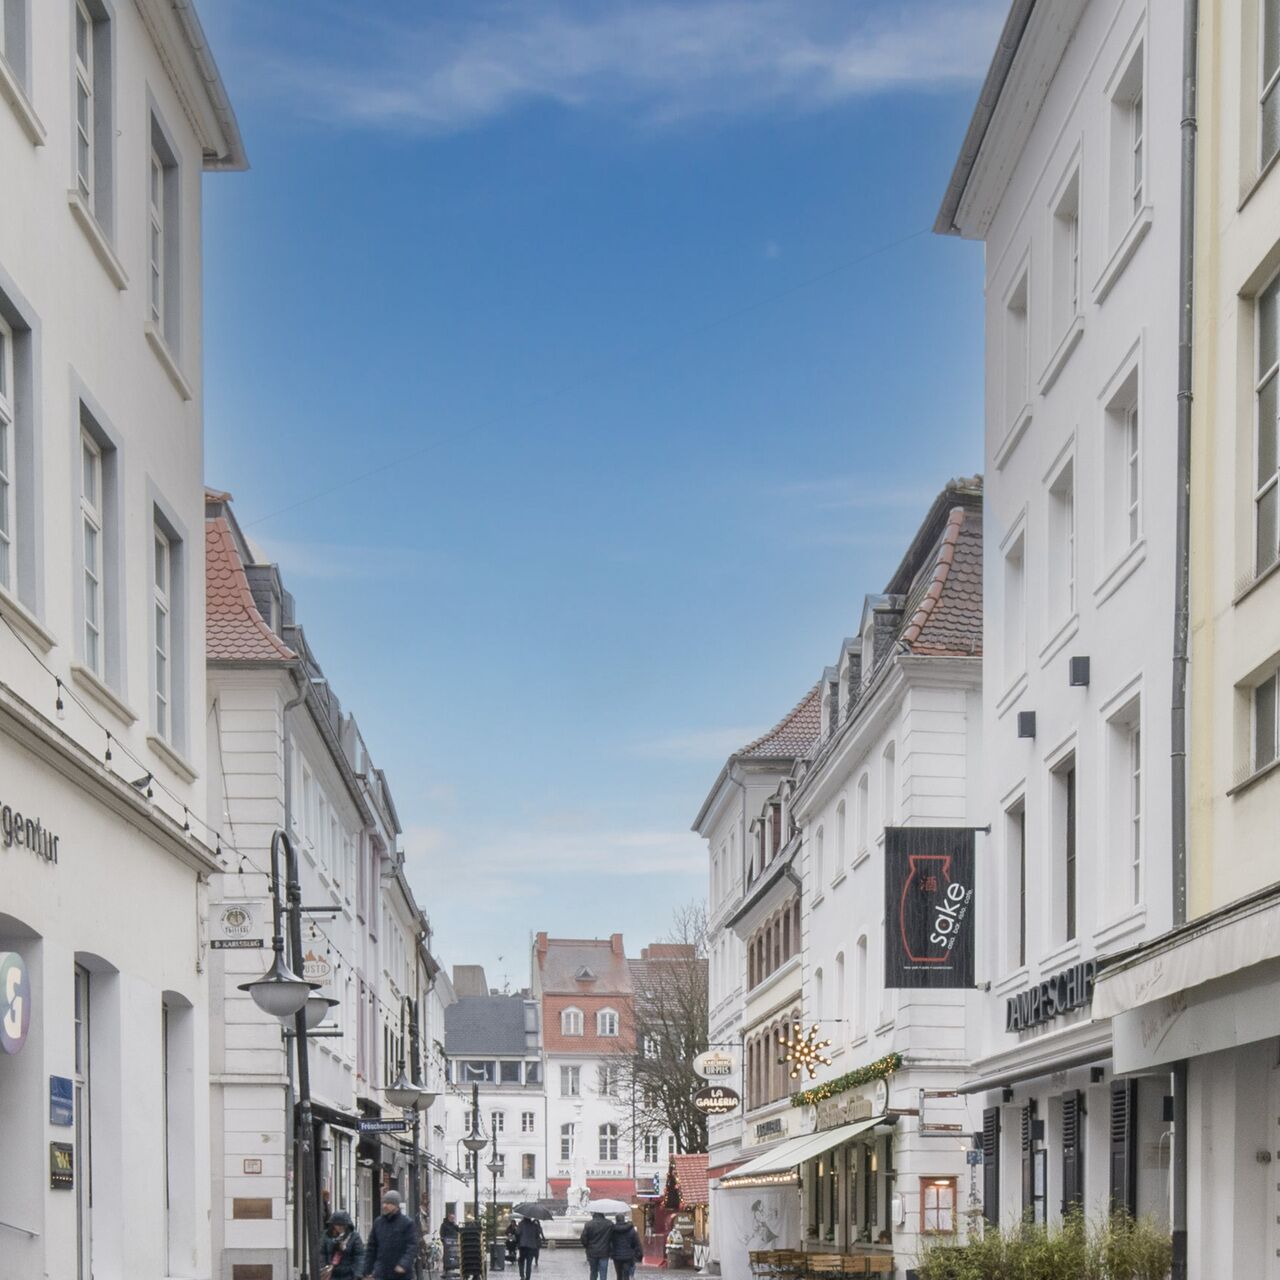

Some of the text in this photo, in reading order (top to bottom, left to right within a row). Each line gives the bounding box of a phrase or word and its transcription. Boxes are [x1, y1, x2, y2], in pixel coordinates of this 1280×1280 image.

[930, 883, 965, 947] sake
[710, 1089, 724, 1098] LA
[695, 1097, 739, 1107] GALLERIA
